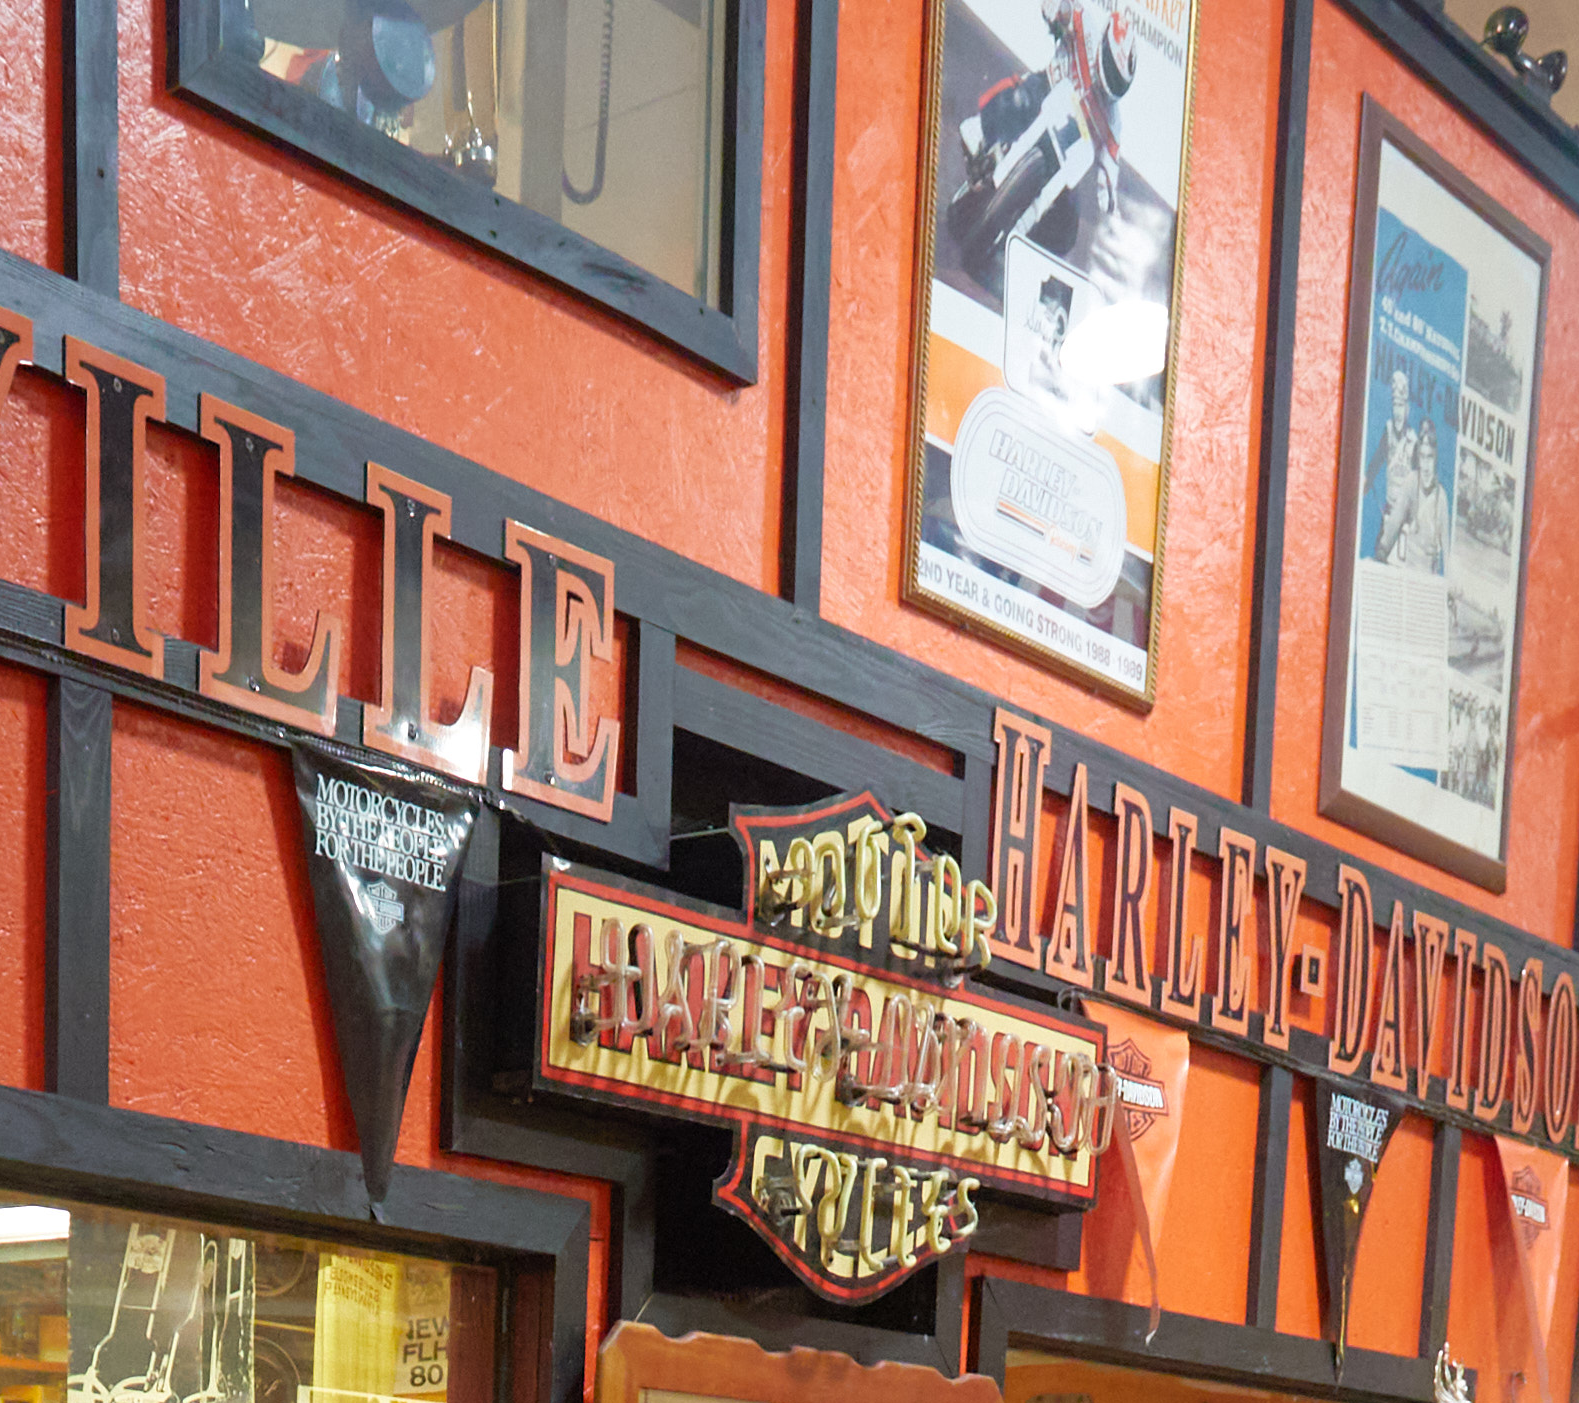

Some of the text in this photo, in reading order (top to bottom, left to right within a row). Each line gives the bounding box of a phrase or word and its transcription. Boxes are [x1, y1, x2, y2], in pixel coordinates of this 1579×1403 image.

[945, 568, 980, 601] YEAR
[981, 587, 991, 609] &
[993, 594, 1035, 628] GOING
[1035, 615, 1083, 654] STRONG
[316, 772, 447, 840] MOTORCYCLES.
[314, 828, 353, 864] FOR
[385, 849, 447, 892] PEOPLE.
